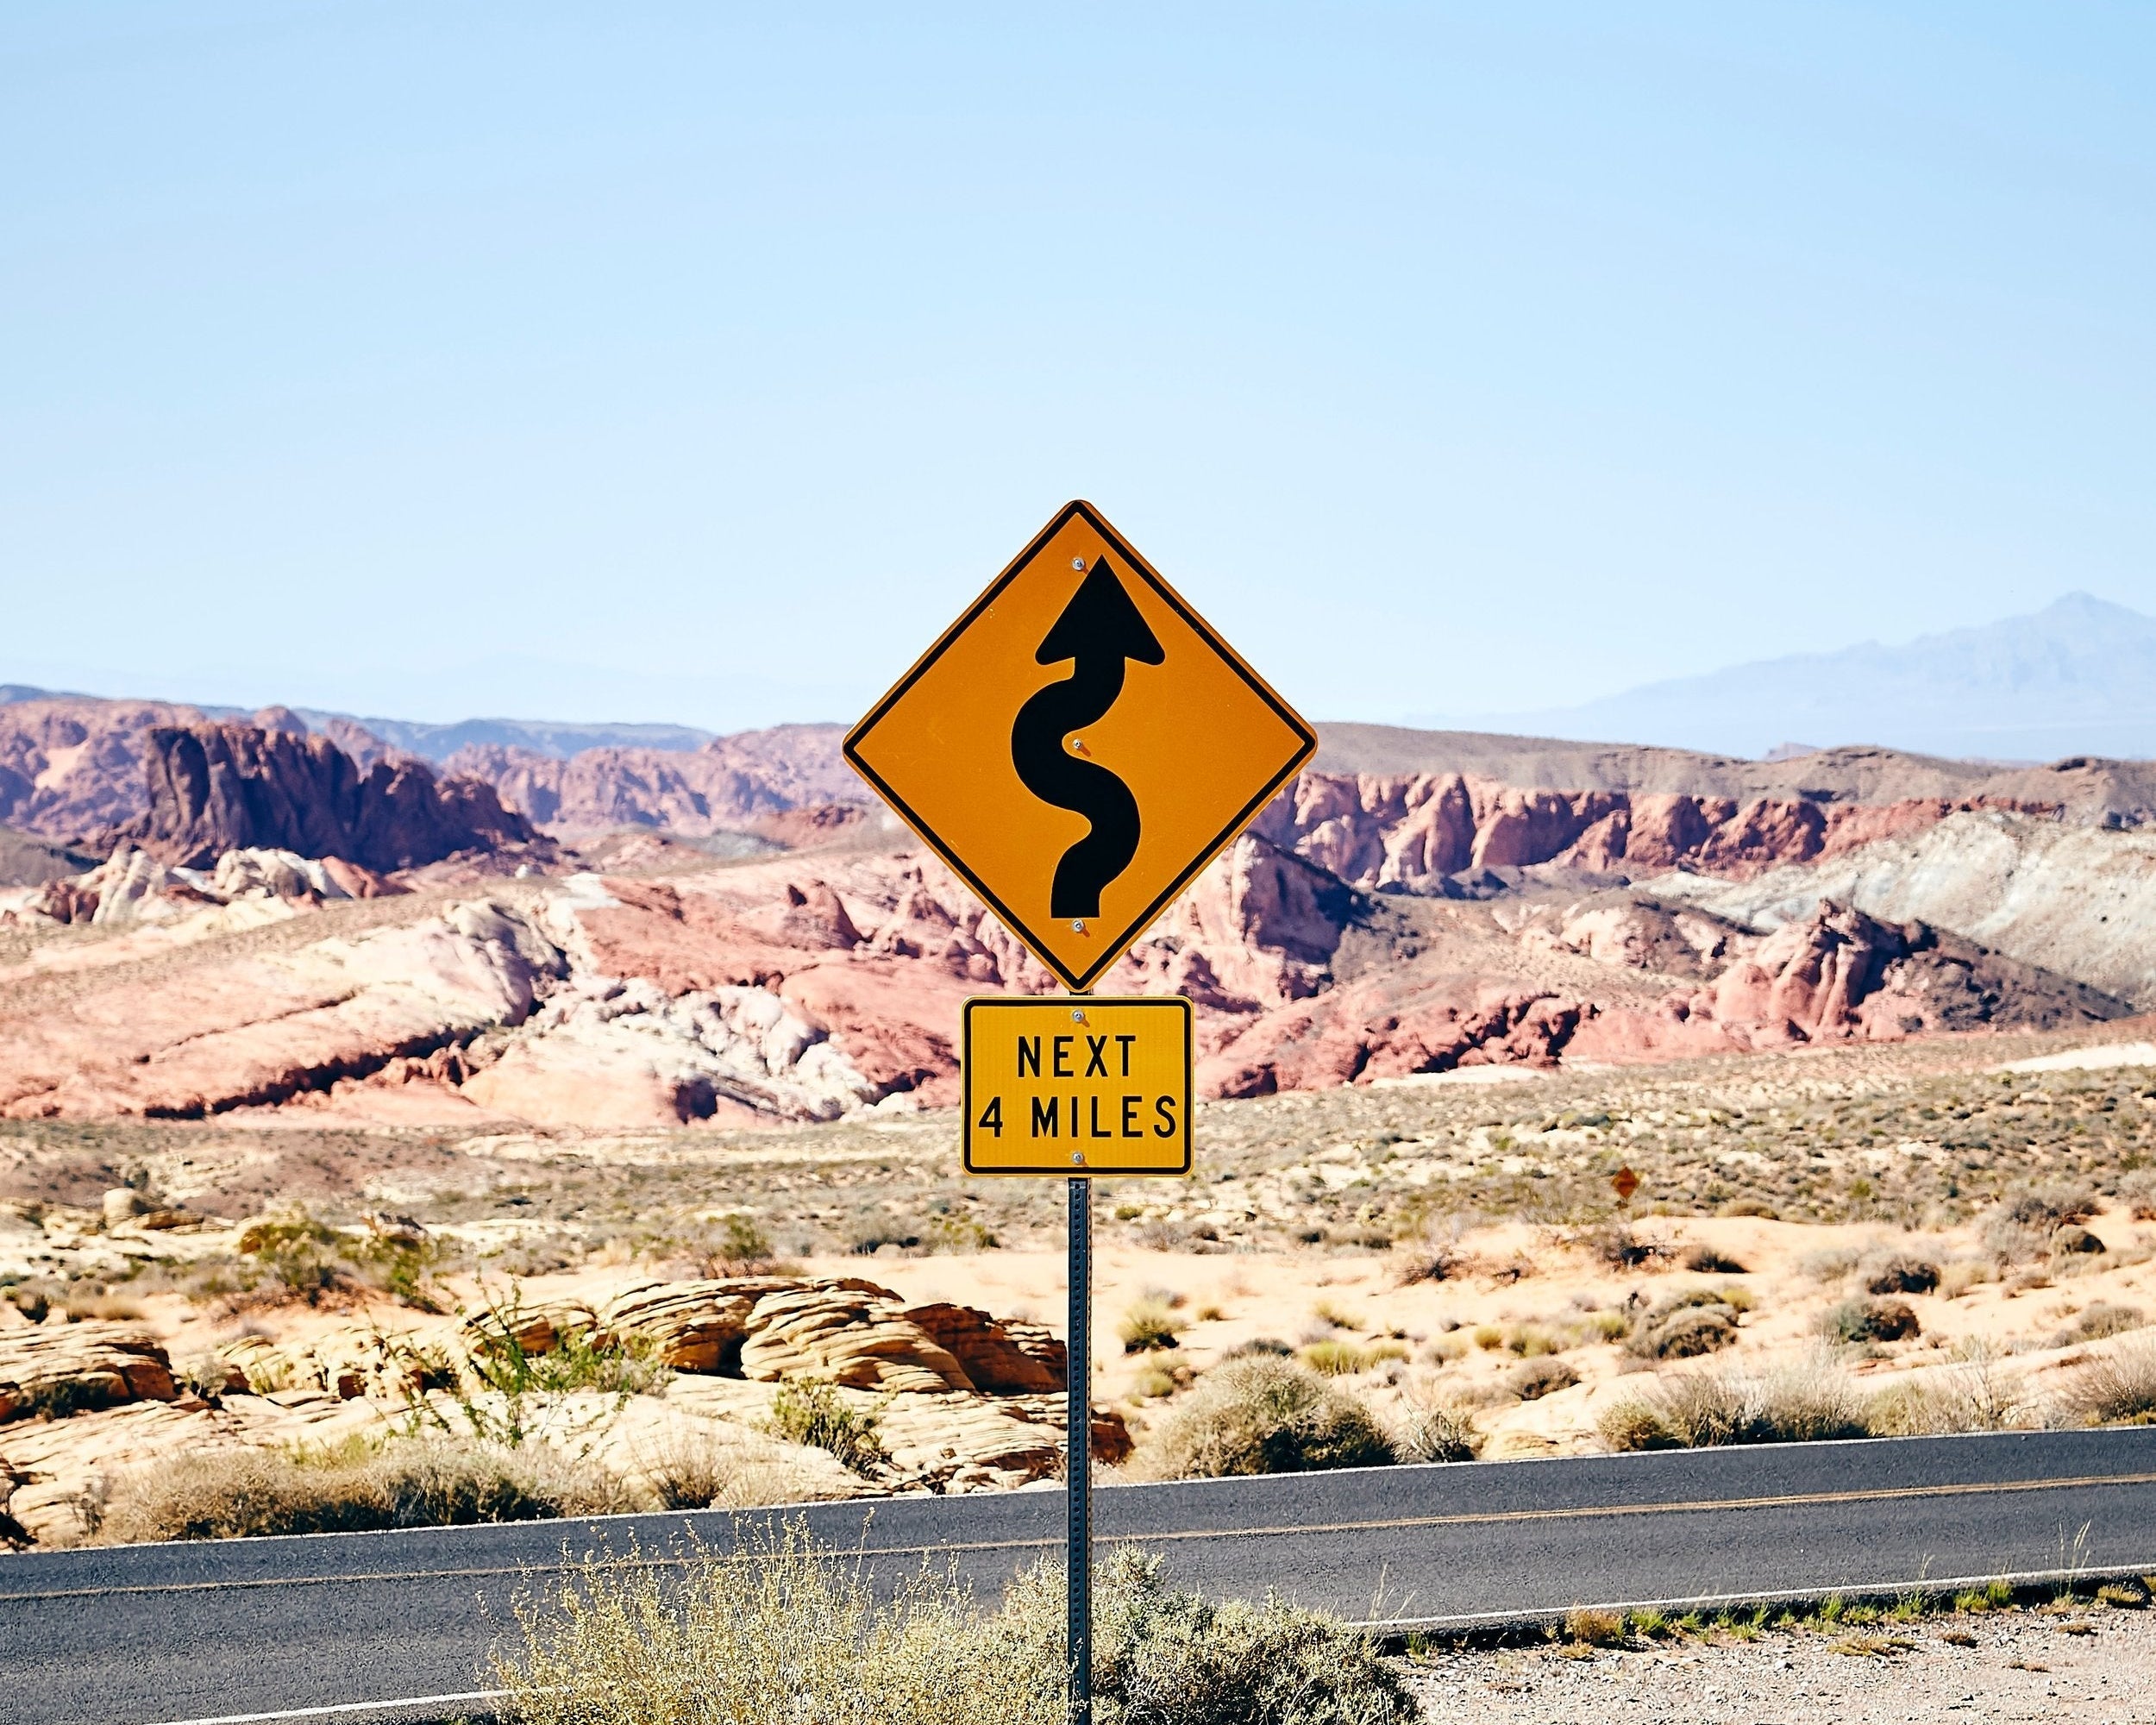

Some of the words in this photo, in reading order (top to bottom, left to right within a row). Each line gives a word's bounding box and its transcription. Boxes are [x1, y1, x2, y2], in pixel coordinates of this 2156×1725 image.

[1018, 1035, 1137, 1078] NEXT
[978, 1096, 1004, 1138] 4
[1031, 1095, 1176, 1138] MILES
